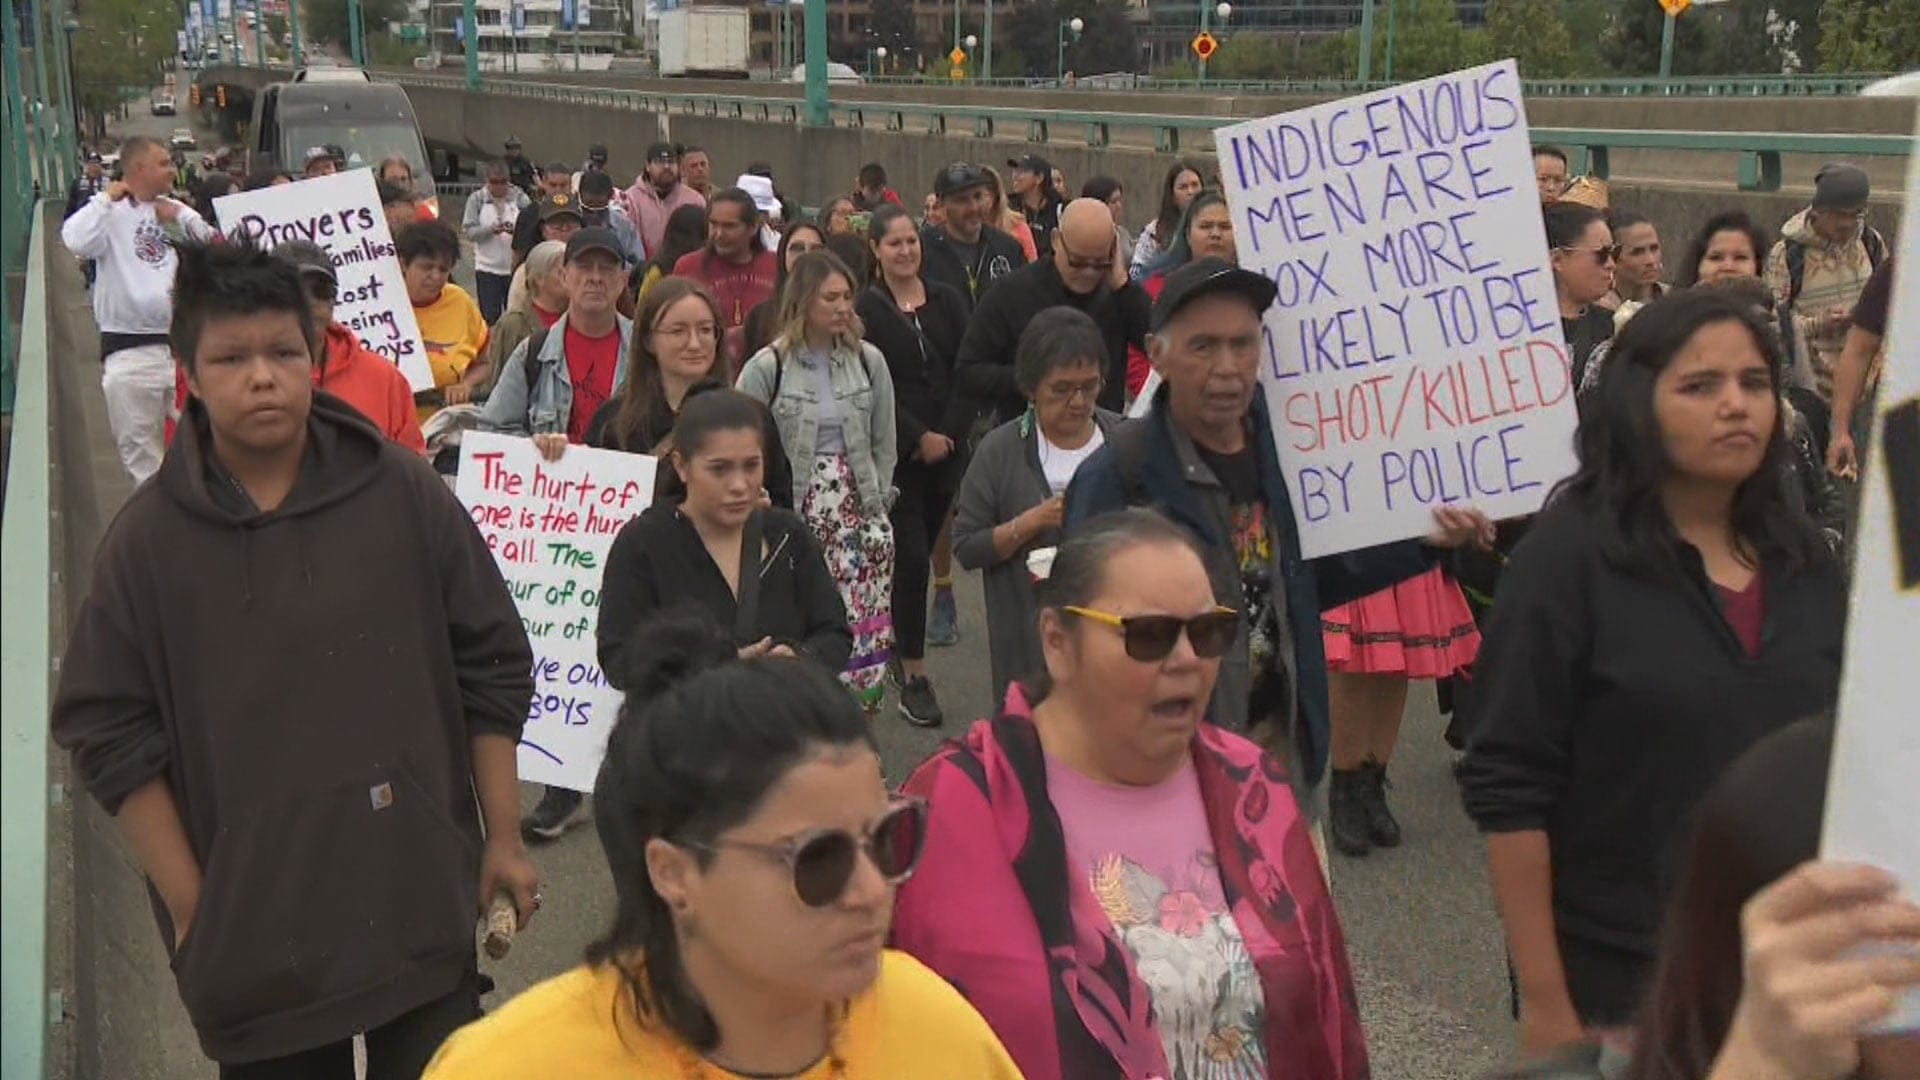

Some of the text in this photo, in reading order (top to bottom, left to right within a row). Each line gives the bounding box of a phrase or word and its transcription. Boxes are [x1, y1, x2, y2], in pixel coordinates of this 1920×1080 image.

[1231, 69, 1518, 189] INDIGENOUS
[241, 207, 374, 248] Prayers
[1247, 140, 1513, 252] MEN ARE
[1363, 211, 1501, 293] MORE
[1262, 268, 1555, 380] LIKELY TO BE
[1286, 340, 1572, 452] SHOT/KILLED
[472, 452, 639, 508] The hurt of
[1300, 424, 1543, 524] BY POLICE
[520, 507, 535, 529] is
[540, 504, 578, 533] the
[584, 504, 637, 536] hur
[547, 543, 597, 568] The
[545, 579, 577, 605] of
[563, 616, 589, 640] of
